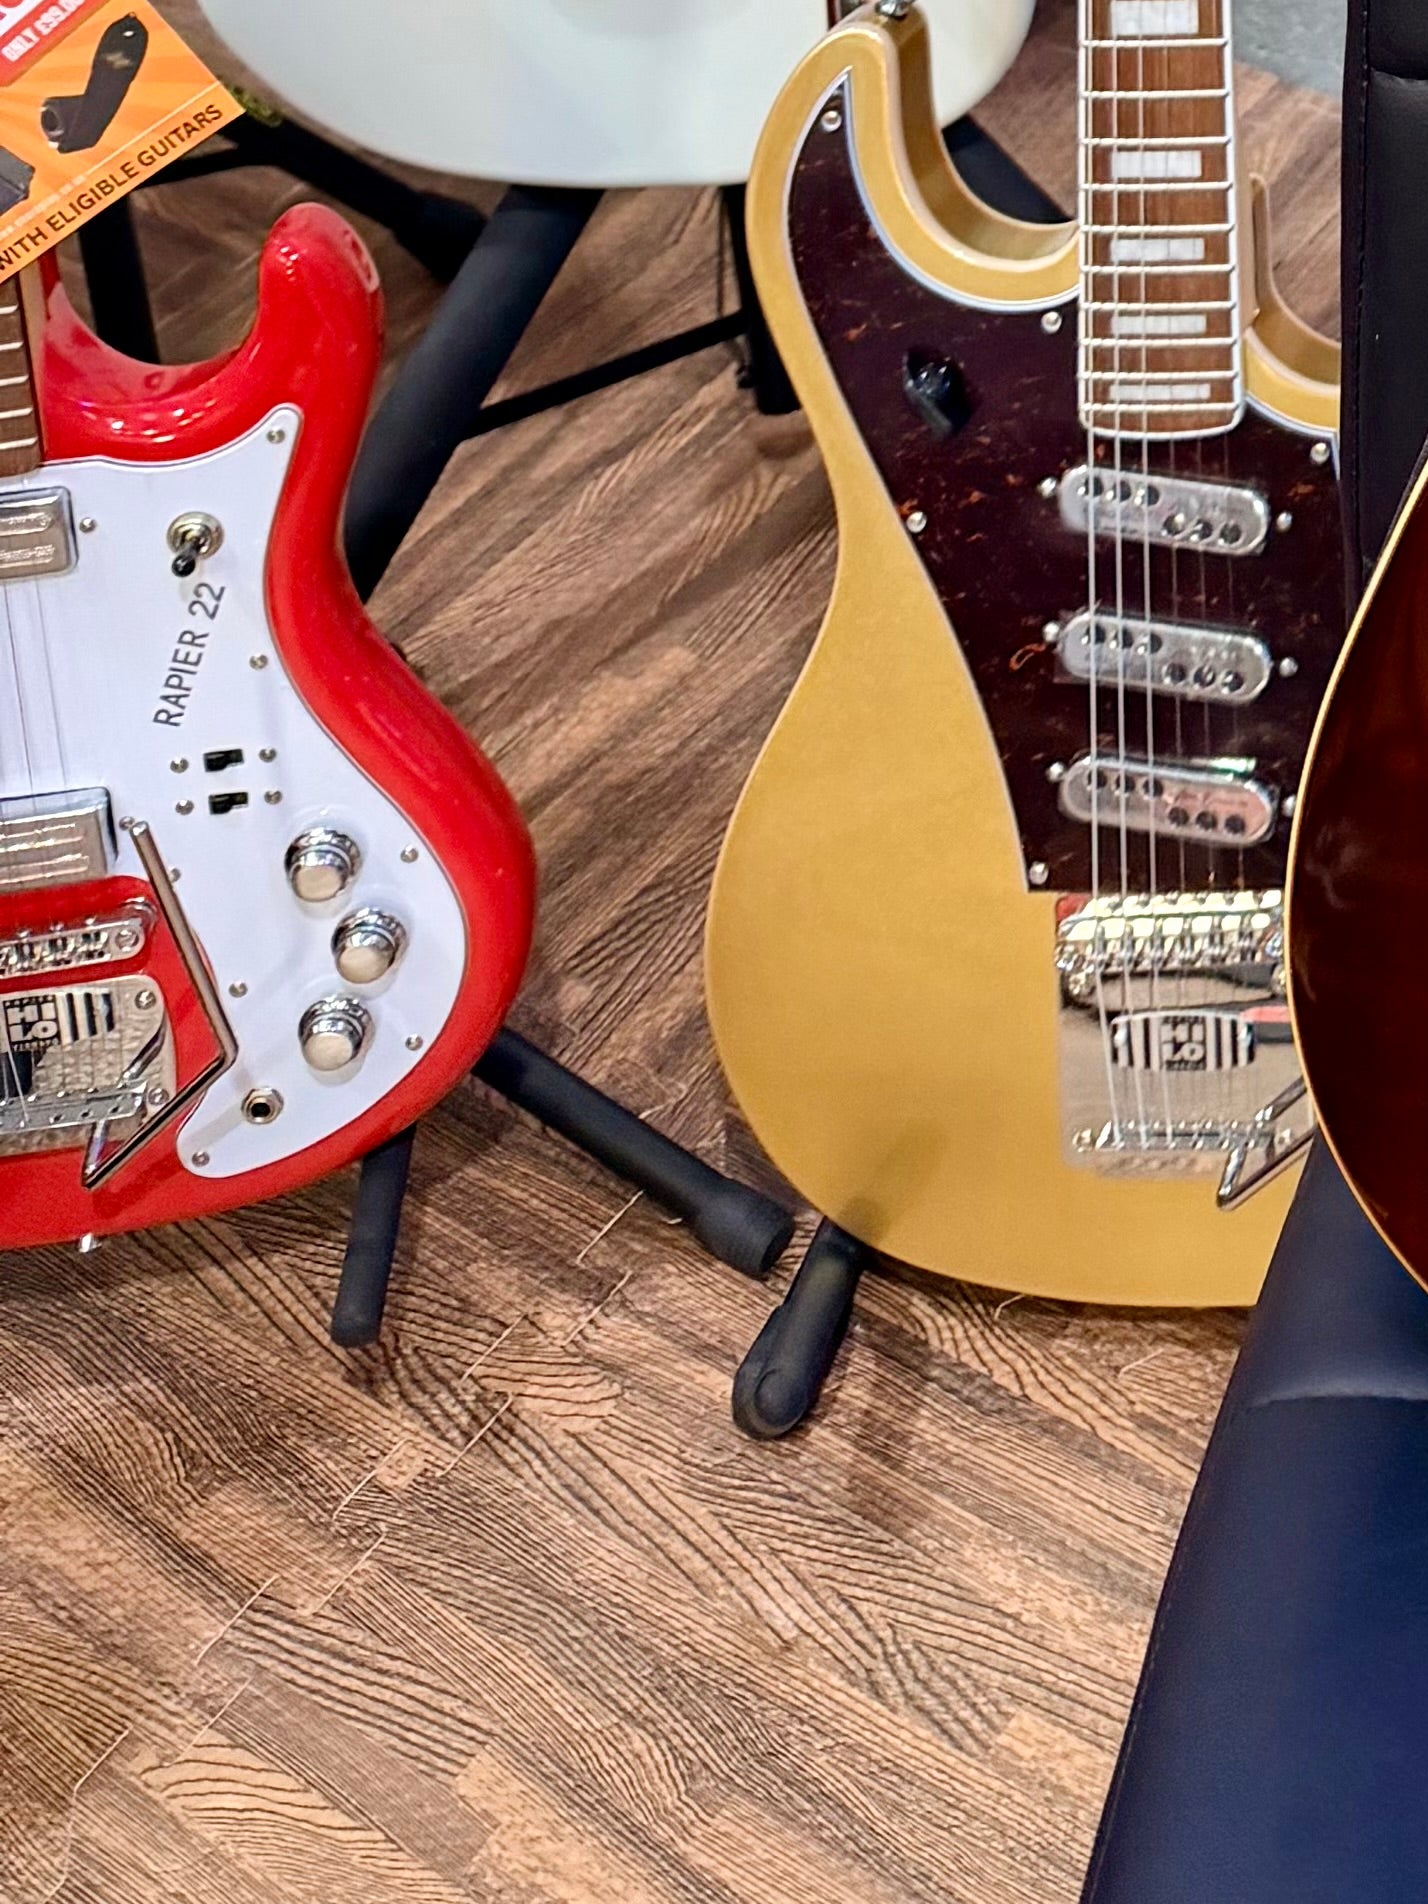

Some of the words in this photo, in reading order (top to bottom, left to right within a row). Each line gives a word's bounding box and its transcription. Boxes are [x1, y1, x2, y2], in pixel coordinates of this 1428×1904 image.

[45, 160, 140, 233] ELIGIBLE
[137, 103, 224, 167] GUITARS
[151, 628, 209, 729] RAPIER
[188, 580, 228, 620] 22
